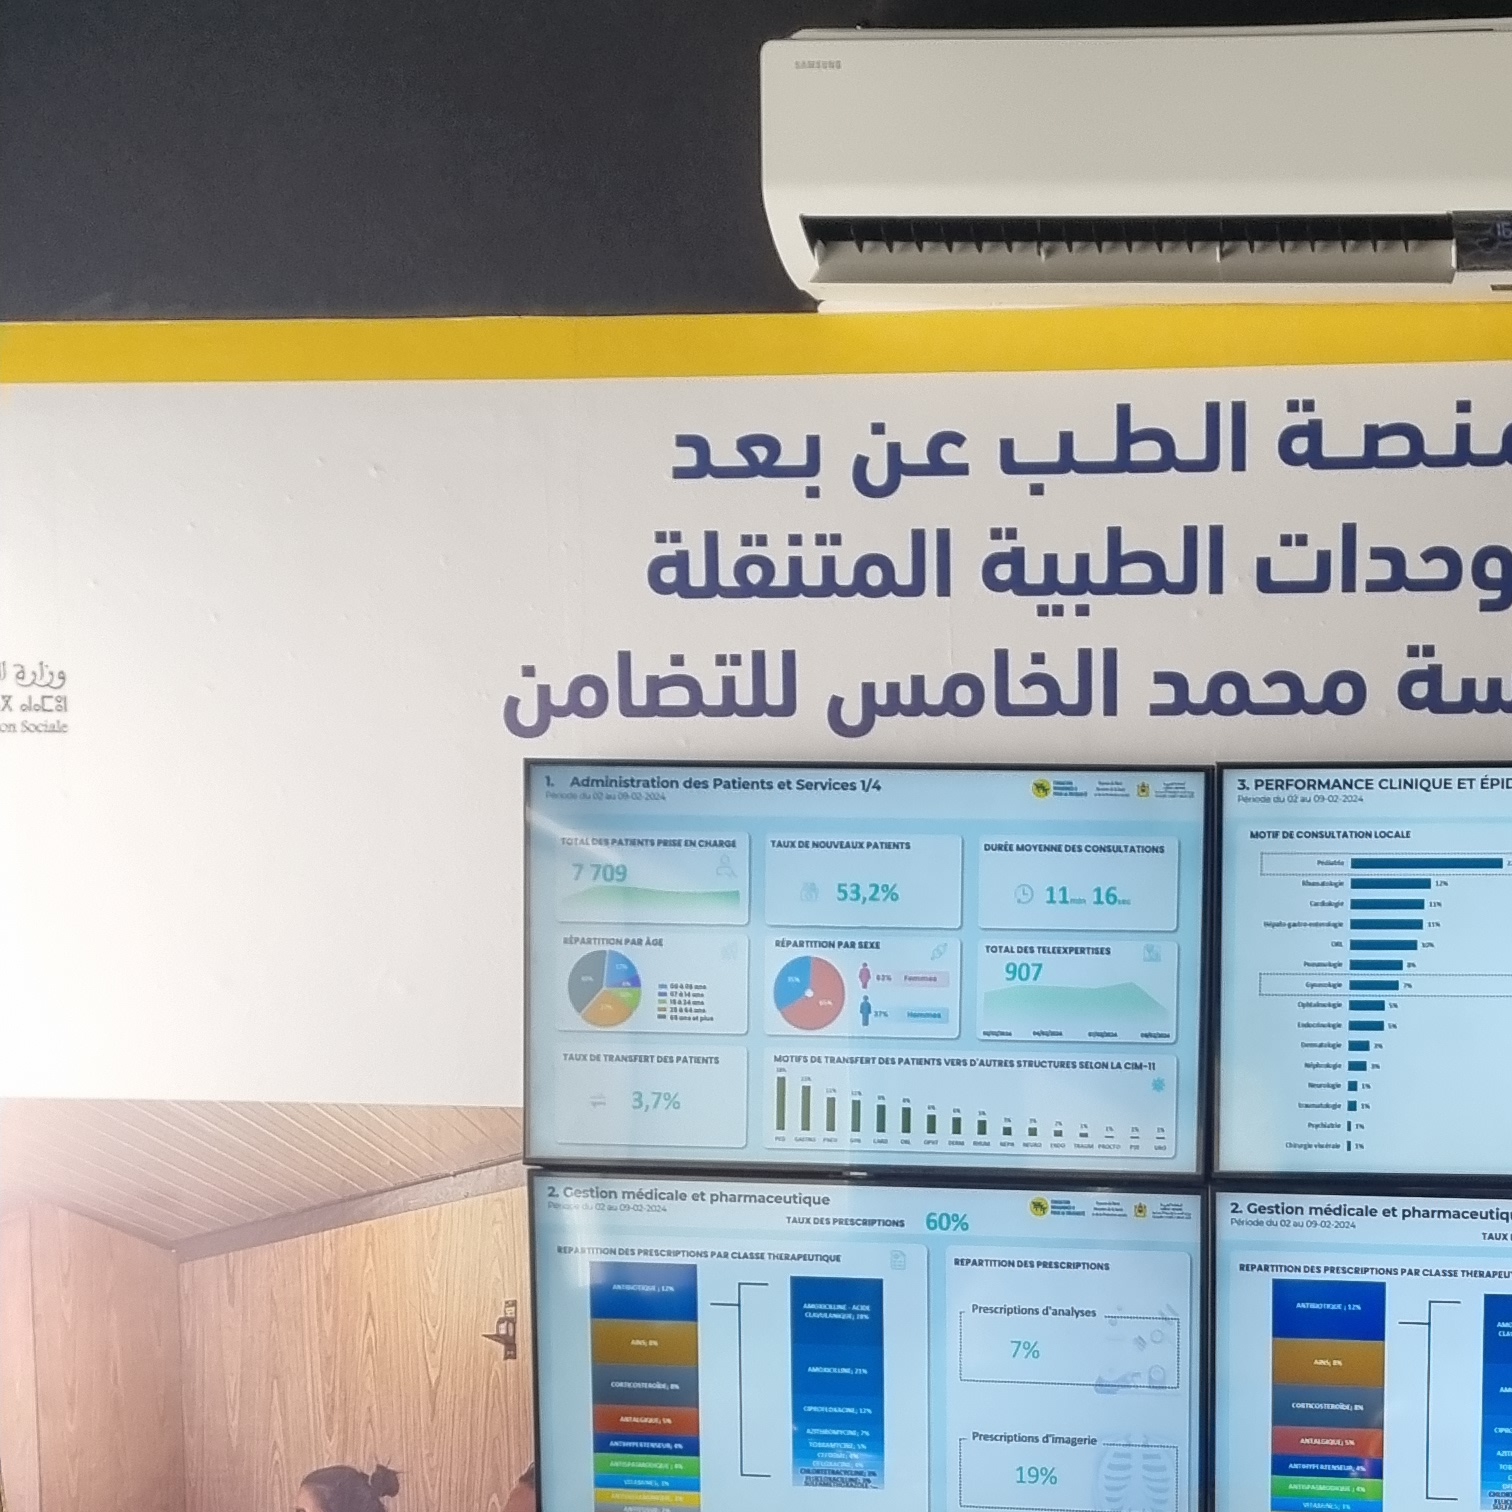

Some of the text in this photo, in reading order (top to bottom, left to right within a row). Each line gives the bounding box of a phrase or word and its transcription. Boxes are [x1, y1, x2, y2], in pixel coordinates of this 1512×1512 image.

[999, 400, 1247, 496] الطب
[671, 432, 821, 499] بعد
[851, 421, 970, 499] عن
[646, 527, 951, 599] المتنقلة
[980, 524, 1224, 617] الطبية
[502, 648, 797, 739] للتضامن
[827, 646, 1118, 739] الخامس
[1149, 668, 1368, 717] محمد
[570, 776, 679, 790] Administration
[683, 777, 709, 790] des
[713, 777, 774, 791] Patients
[777, 778, 793, 791] et
[795, 778, 856, 792] Services
[859, 778, 882, 792] 1/4
[1236, 778, 1249, 790] 3.
[1253, 777, 1374, 791] PERFORMANCE
[1377, 778, 1452, 793] CLINIQUE
[1457, 778, 1477, 790] ET
[610, 838, 655, 847] PATIENTS
[656, 838, 682, 848] PRISE
[684, 839, 697, 848] EN
[698, 839, 737, 848] CHARGE
[1250, 830, 1411, 840] MOTIF DE CONSULTATION LOCALE
[770, 839, 911, 851] TAUX DE NOUVEAUX PATIENTS
[984, 841, 1165, 854] DURÉE MOYENNE DES CONSULTATIONS
[591, 864, 628, 882] 709
[623, 936, 642, 946] PAR
[837, 940, 856, 950] PAR
[858, 940, 881, 951] SEXE
[985, 944, 1111, 956] TOTAL DES TELEEXPERTISES
[1004, 962, 1043, 982] 907
[563, 1052, 720, 1065] TAUX DE TRANSFERT DES PATIENTS
[774, 1054, 808, 1064] MOTIFS
[810, 1055, 822, 1064] DE
[824, 1056, 877, 1066] TRANSFERT
[878, 1057, 896, 1067] DES
[897, 1057, 942, 1067] PATIENTS
[944, 1058, 968, 1068] VERS
[969, 1058, 1015, 1069] D'AUTRES
[1016, 1059, 1077, 1070] STRUCTURES
[1079, 1060, 1109, 1071] SELON
[1110, 1062, 1122, 1071] LA
[631, 1091, 681, 1112] 3,7%
[547, 1186, 831, 1208] 2. Gestion médicale et pharmaceutique
[1230, 1202, 1243, 1214] 2.
[1246, 1202, 1304, 1216] Gestion
[1308, 1203, 1378, 1218] médicale
[1381, 1205, 1398, 1218] et
[786, 1215, 906, 1228] TAUX DES PRESCRIPTIONS
[925, 1212, 970, 1232] 60%
[1266, 1218, 1278, 1227] du
[1280, 1219, 1292, 1228] 02
[1293, 1219, 1304, 1228] au
[1305, 1219, 1356, 1230] 09-02-2024
[1482, 1232, 1508, 1242] TAUX
[618, 1248, 636, 1257] DES
[637, 1248, 709, 1260] PRESCRIPTIONS
[710, 1250, 729, 1260] PAR
[730, 1250, 765, 1261] CLASSE
[767, 1252, 842, 1264] THERAPEUTIQUE
[954, 1257, 1110, 1272] REPARTITION DES PRESCRIPTIONS
[1239, 1263, 1302, 1274] REPARTITION
[1303, 1265, 1322, 1275] DES
[1323, 1265, 1399, 1277] PRESCRIPTIONS
[1400, 1267, 1420, 1277] PAR
[1421, 1267, 1458, 1278] CLASSE
[971, 1302, 1098, 1320] Prescriptions d'analyses
[1009, 1340, 1041, 1360] 7%
[971, 1430, 1098, 1449] Prescriptions d'imagerie
[1015, 1465, 1059, 1486] 19%
